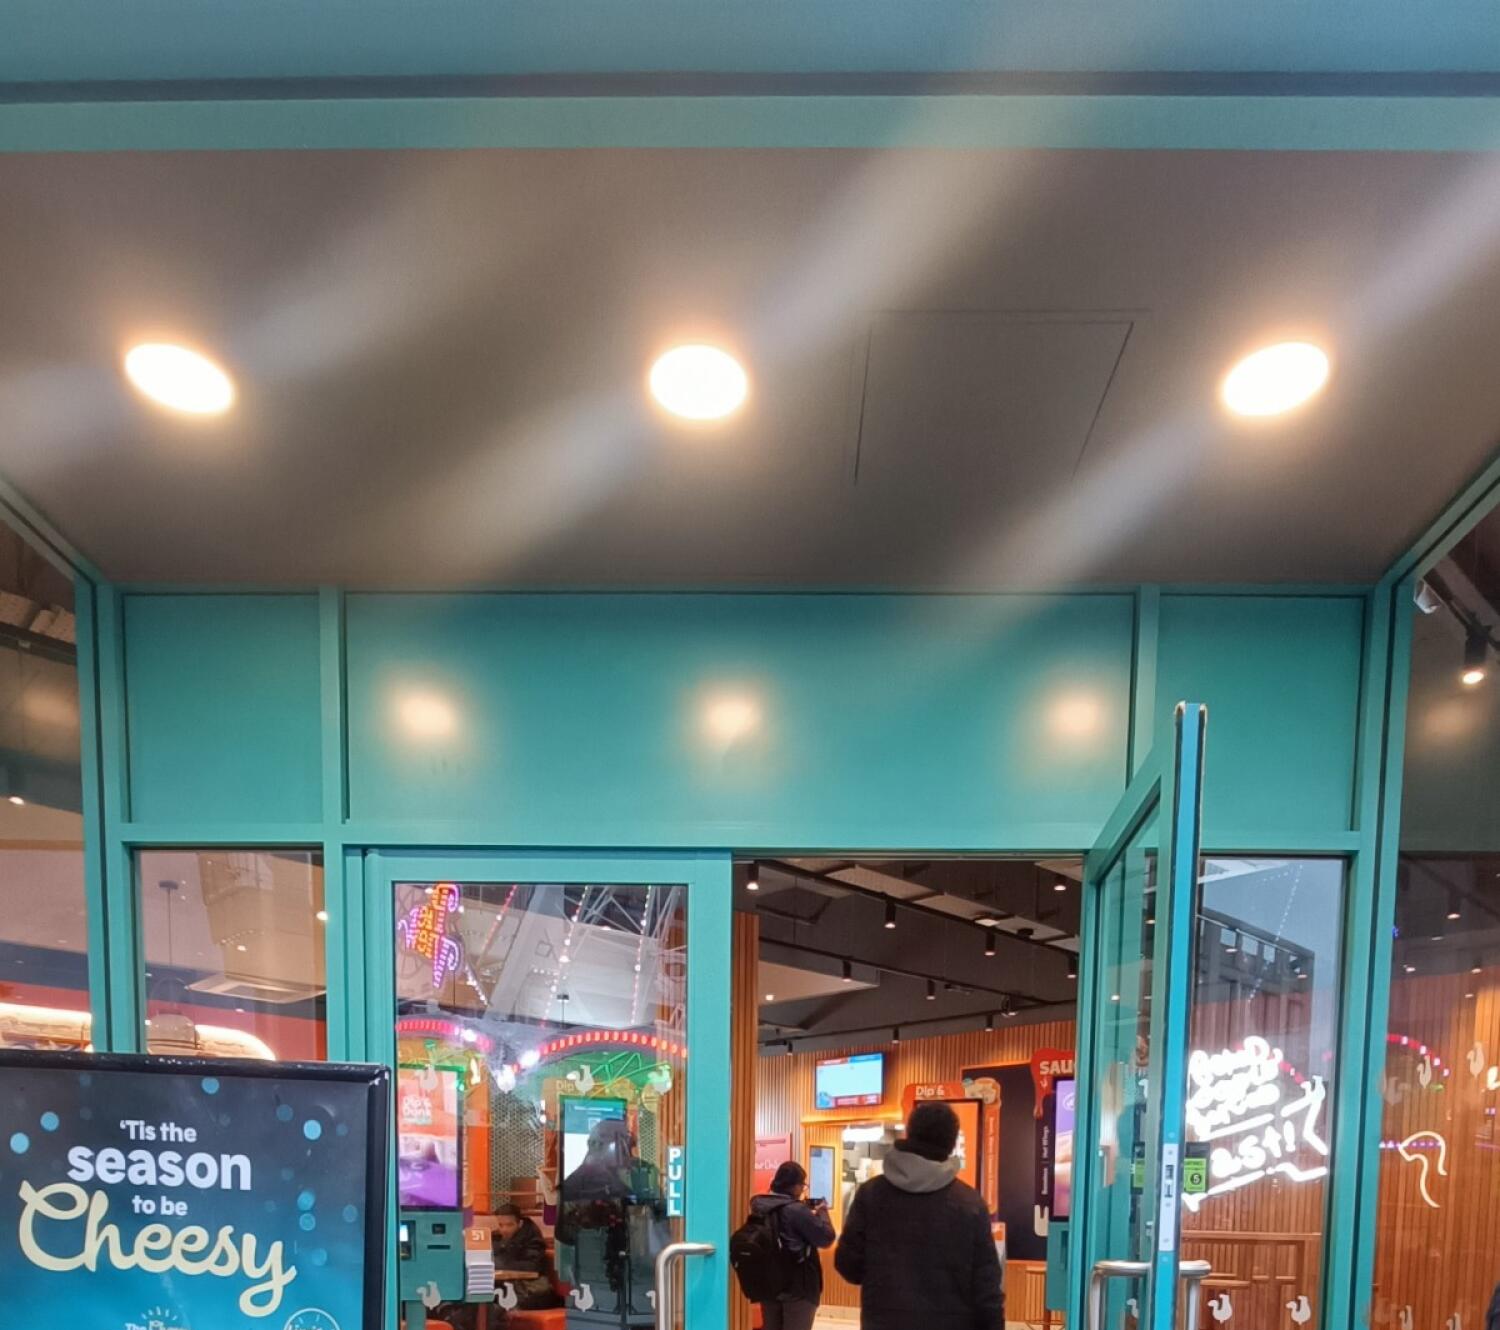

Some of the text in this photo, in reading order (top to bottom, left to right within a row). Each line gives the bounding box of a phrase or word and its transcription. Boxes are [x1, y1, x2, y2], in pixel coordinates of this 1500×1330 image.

[1040, 1059, 1073, 1075] SAU
[916, 1085, 934, 1098] Dip
[160, 1122, 197, 1143] the
[66, 1145, 252, 1191] season
[668, 1147, 682, 1216] PULL
[131, 1195, 189, 1216] to be
[18, 1180, 297, 1317] Cheesy
